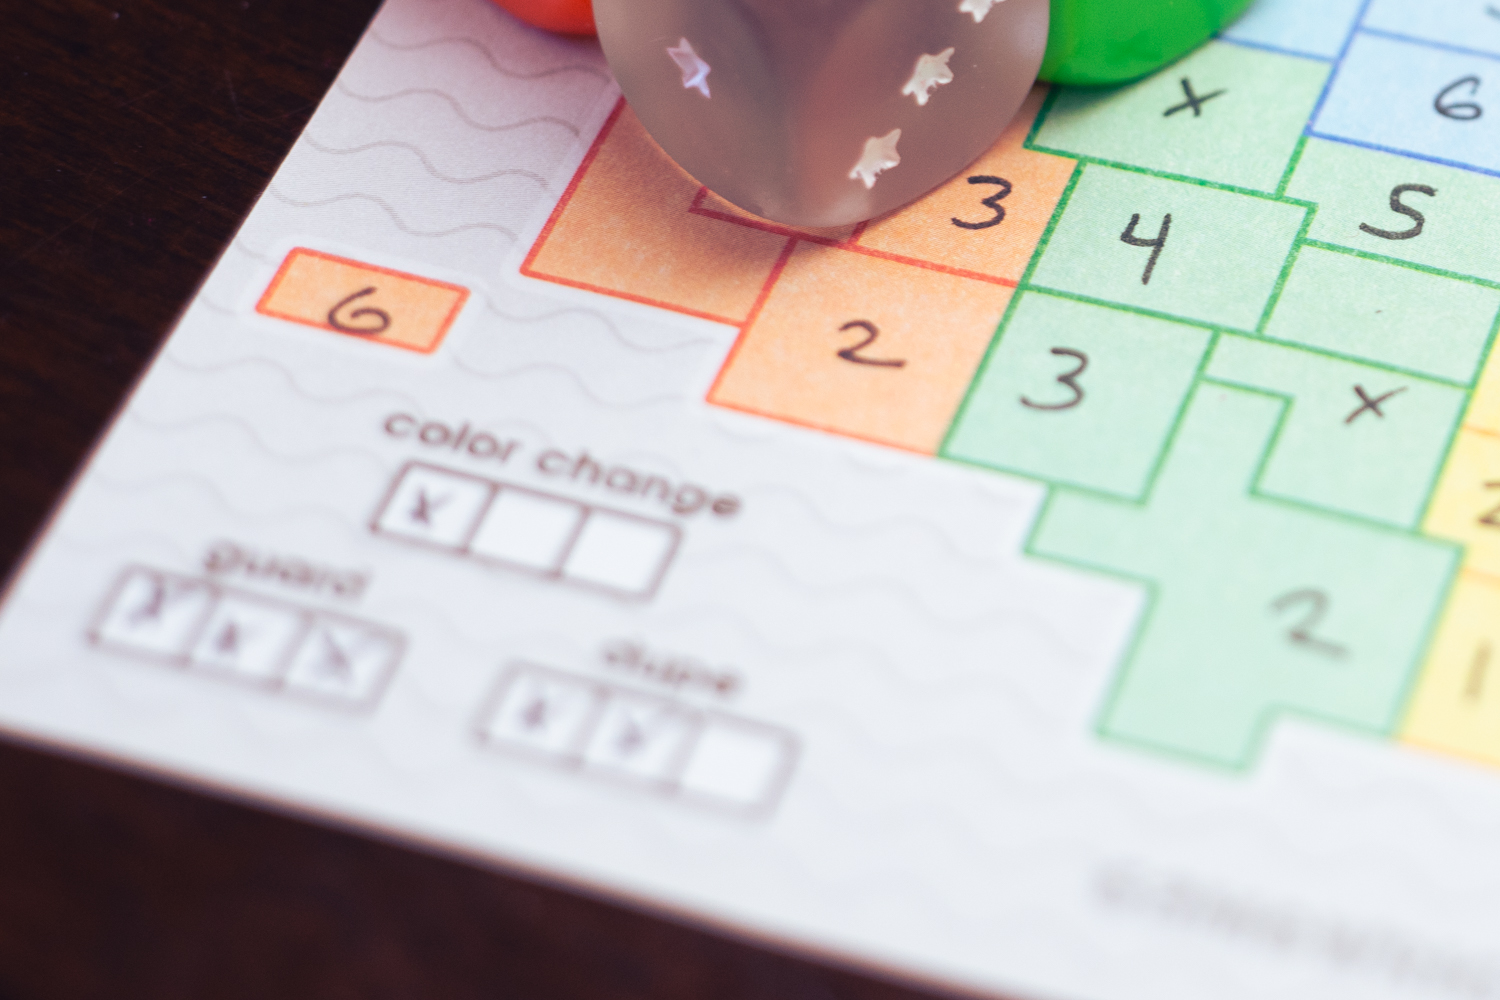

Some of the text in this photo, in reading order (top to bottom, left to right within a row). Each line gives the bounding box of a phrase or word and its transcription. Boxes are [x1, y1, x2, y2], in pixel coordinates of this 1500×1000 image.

[1433, 76, 1484, 121] 6
[951, 174, 1013, 230] 3
[1359, 183, 1438, 242] 5
[1120, 212, 1172, 285] 4
[327, 286, 392, 336] 6
[836, 319, 908, 369] 2
[1019, 346, 1090, 410] 3
[383, 407, 744, 521] color change
[203, 540, 372, 600] guard
[1270, 586, 1352, 660] 2
